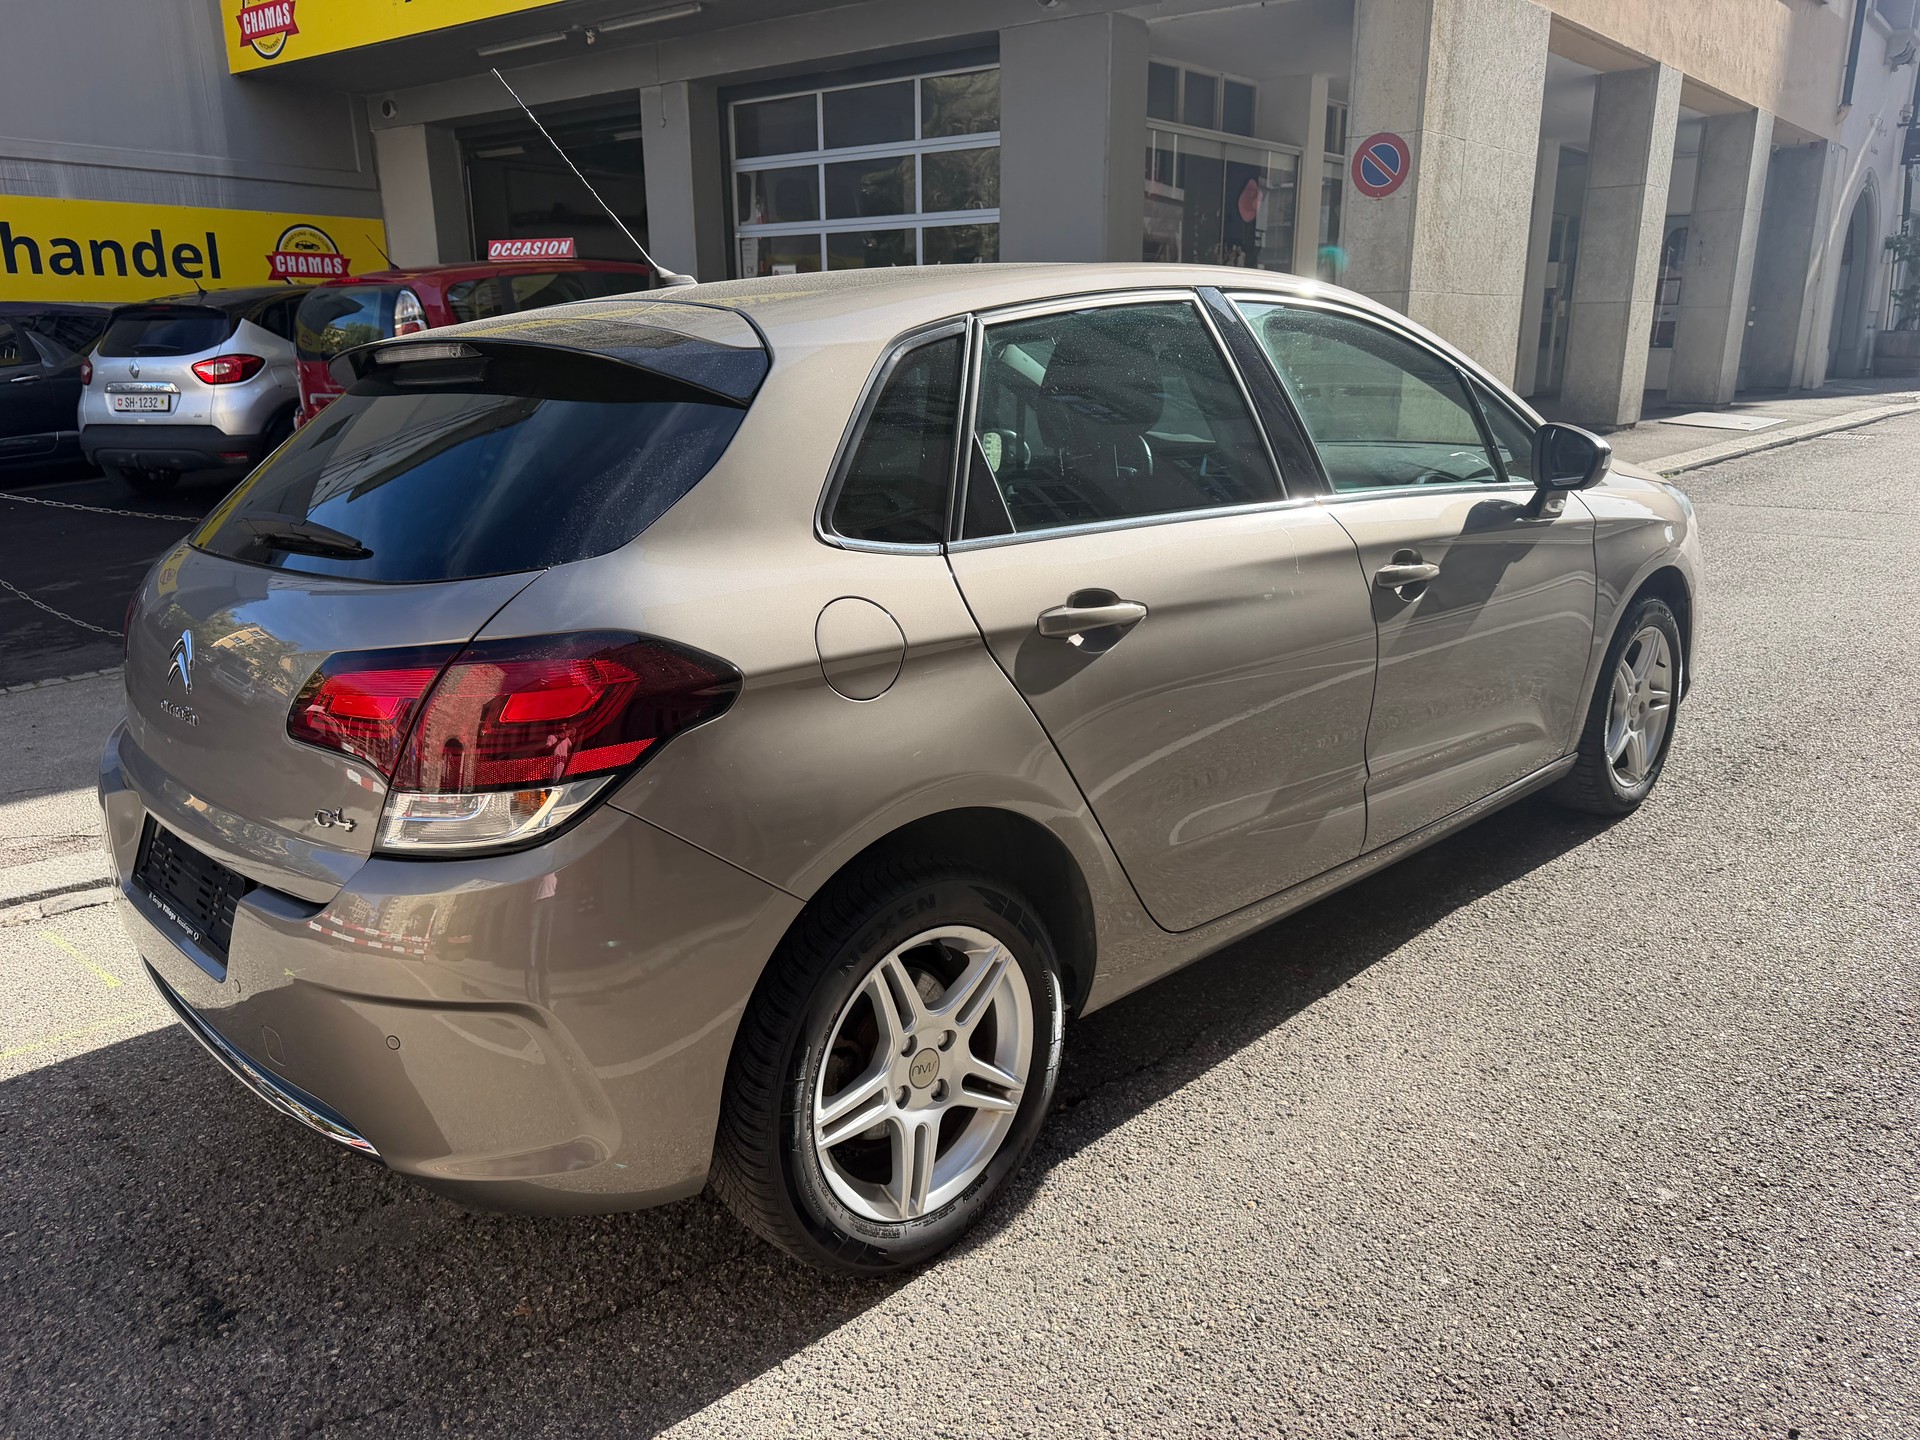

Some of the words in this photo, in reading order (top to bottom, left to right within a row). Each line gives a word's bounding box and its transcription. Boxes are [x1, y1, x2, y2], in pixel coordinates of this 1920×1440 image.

[243, 2, 290, 35] CHAMAS
[0, 221, 221, 279] handel
[490, 240, 571, 257] OCCASION
[275, 255, 343, 274] CHAMAS
[314, 806, 357, 832] C4
[839, 893, 937, 977] NEXEN
